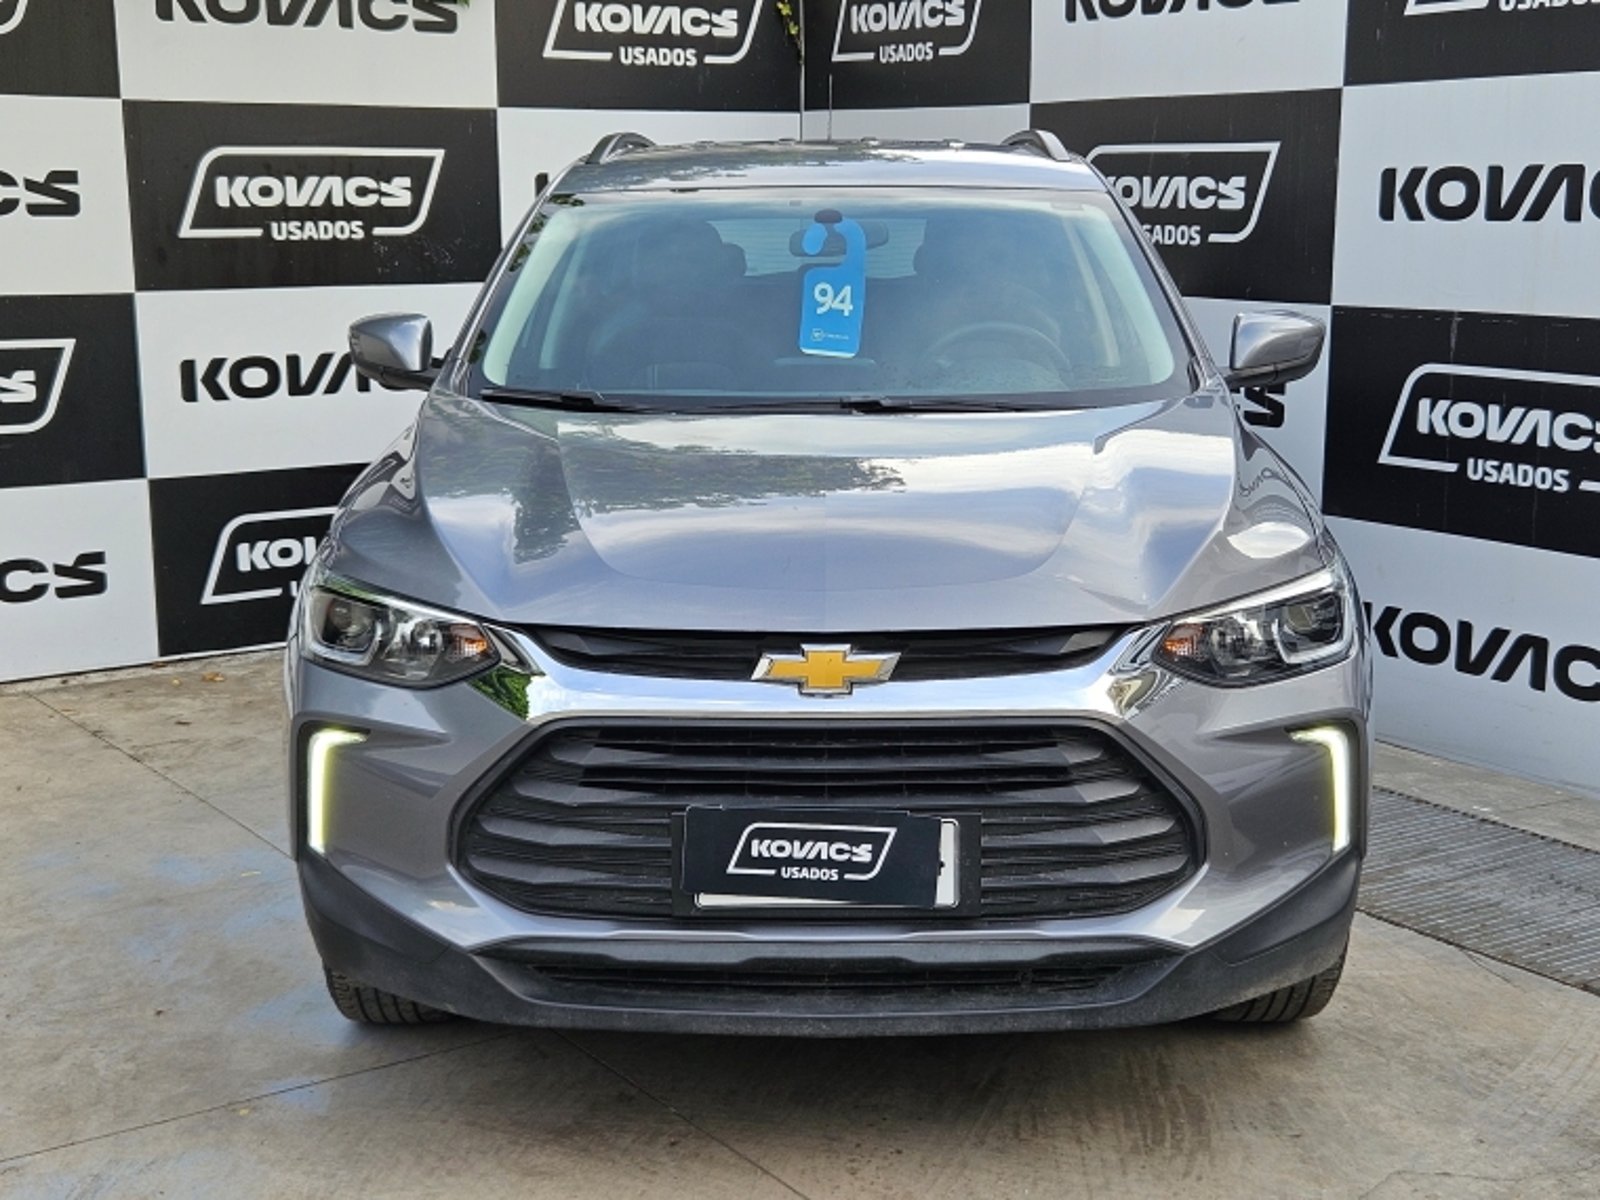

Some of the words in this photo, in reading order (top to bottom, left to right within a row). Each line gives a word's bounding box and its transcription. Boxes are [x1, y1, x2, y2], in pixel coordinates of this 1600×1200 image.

[574, 2, 738, 37] KOVACS
[850, 0, 965, 34] KOVACS
[619, 46, 698, 67] USADOS
[879, 42, 934, 64] USADOS
[215, 175, 412, 208] KOVACS
[1106, 175, 1247, 210] OVACS
[1378, 163, 1600, 223] KOVA
[270, 220, 365, 241] USADOS
[813, 282, 854, 317] 94
[180, 352, 371, 402] KOVA
[1416, 397, 1600, 454] KOVAC
[1466, 457, 1570, 493] USADOS
[750, 838, 873, 863] KOVACS
[780, 866, 839, 881] USADOS
